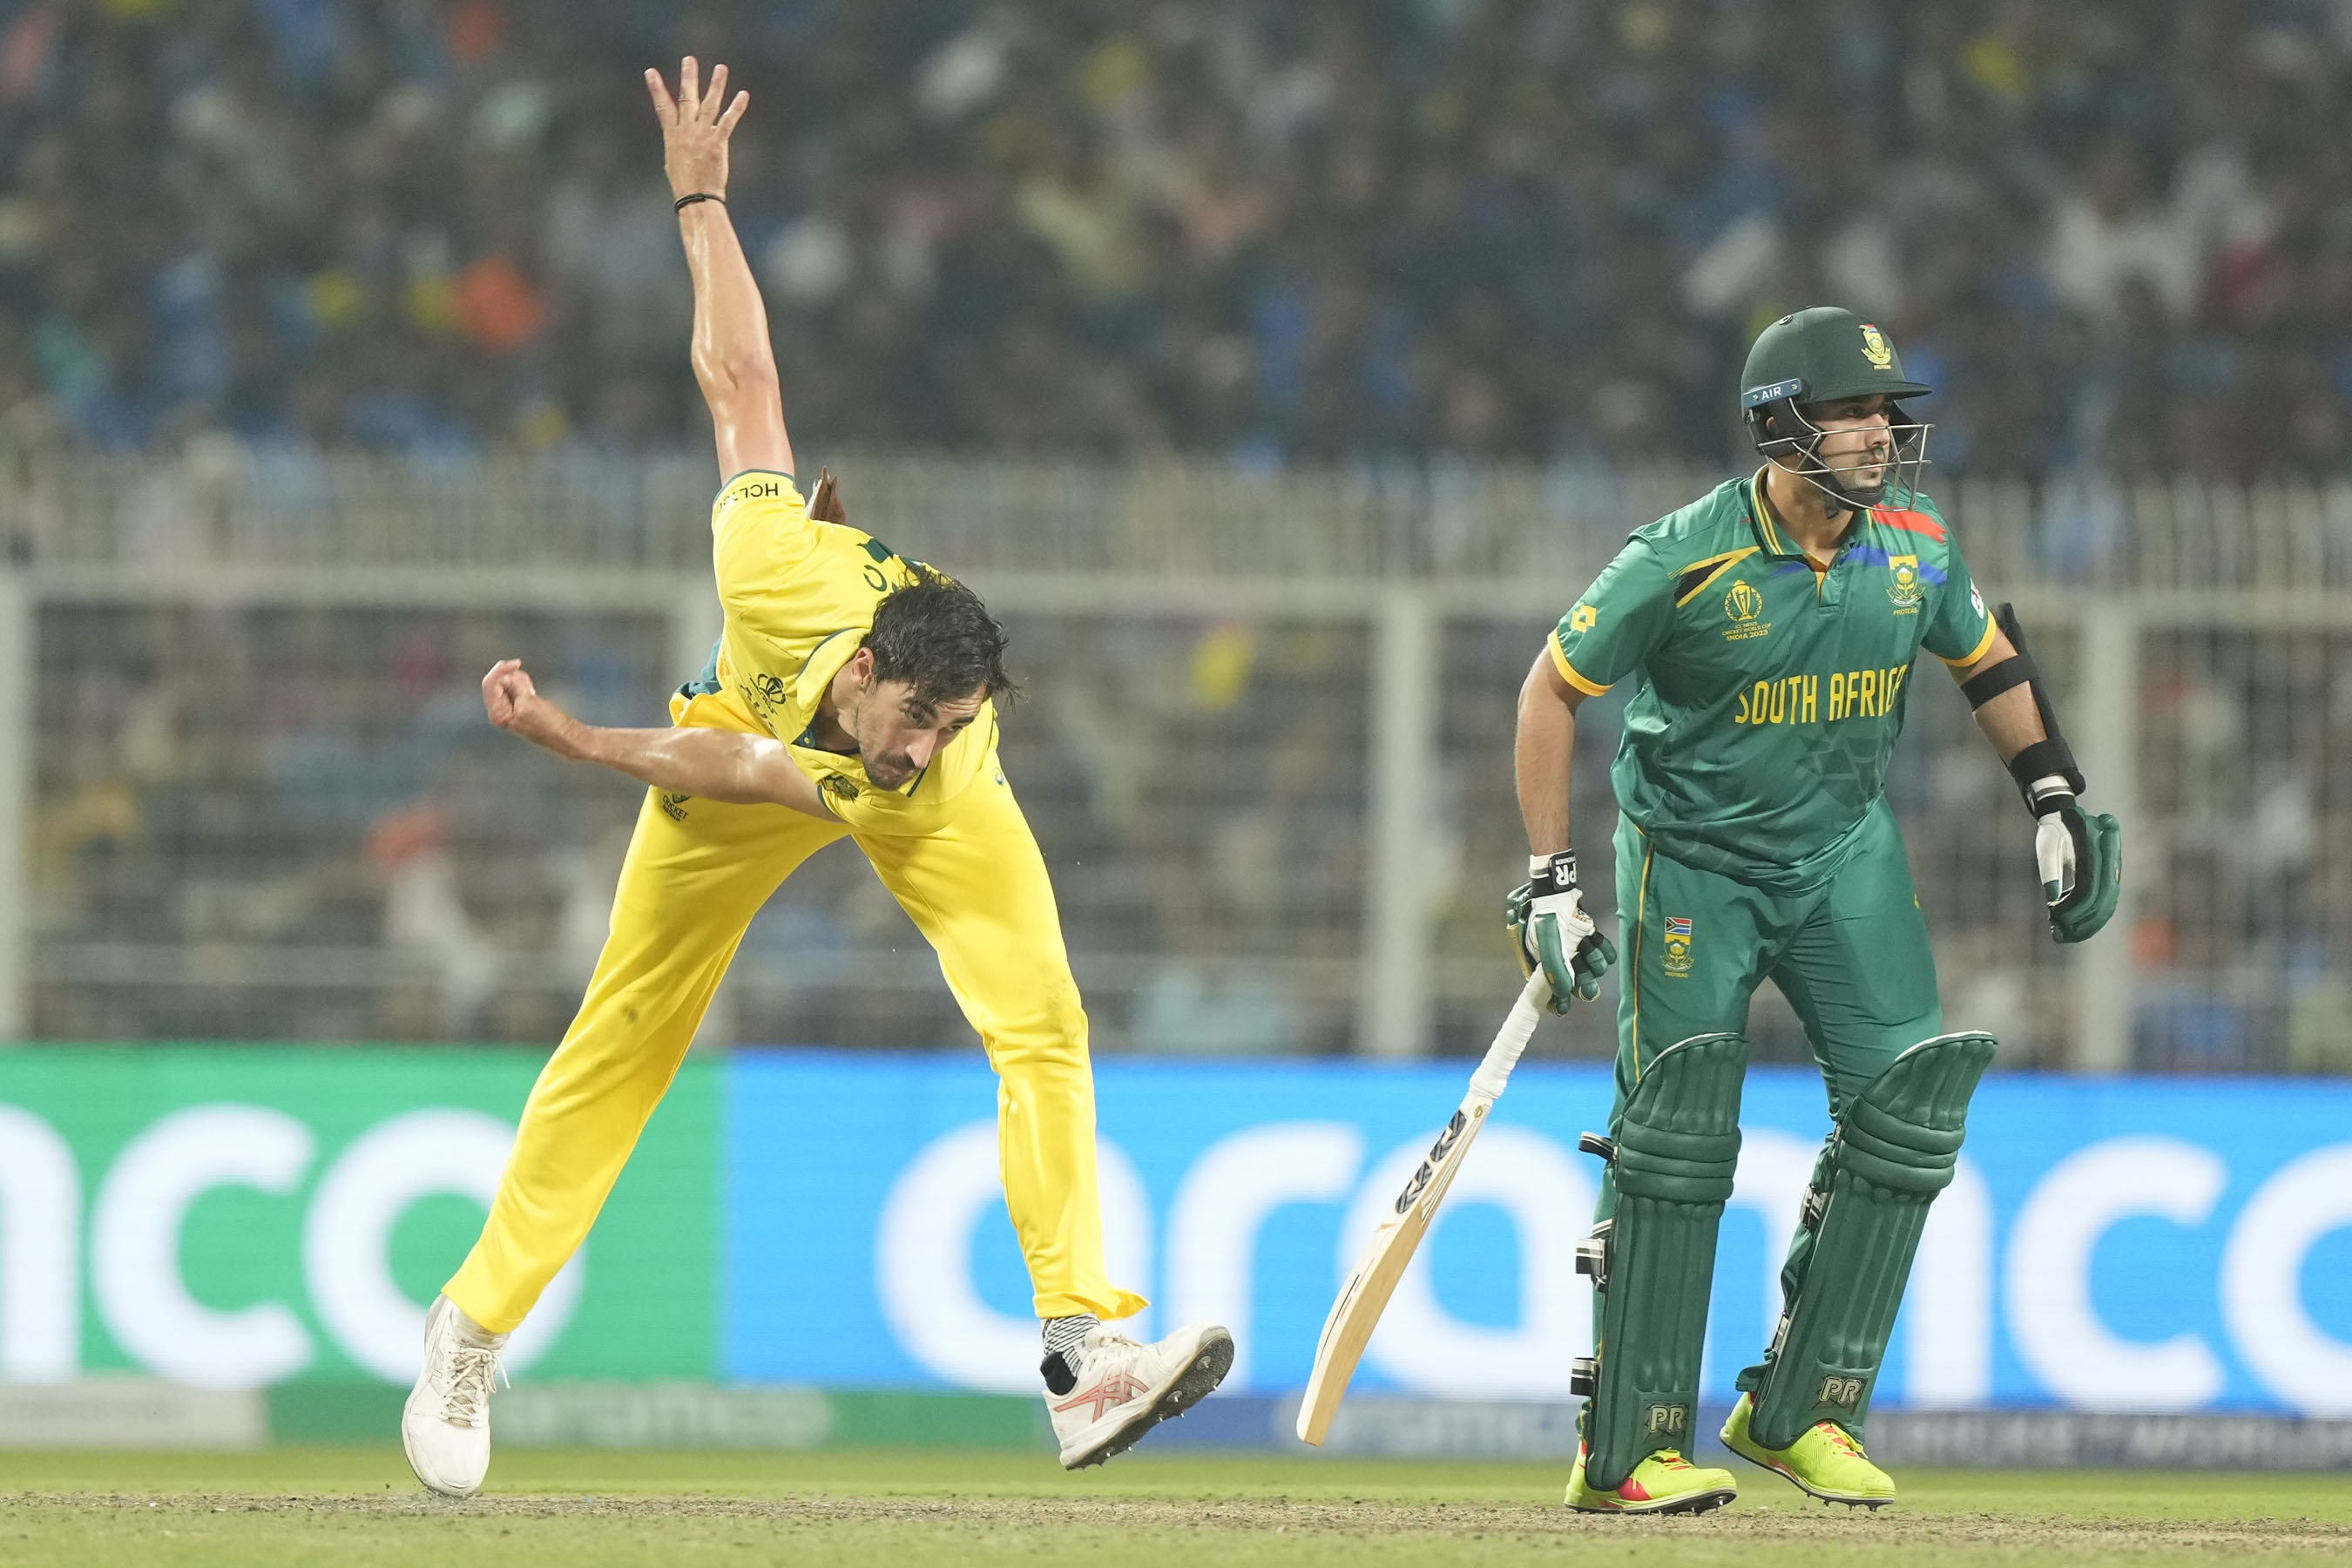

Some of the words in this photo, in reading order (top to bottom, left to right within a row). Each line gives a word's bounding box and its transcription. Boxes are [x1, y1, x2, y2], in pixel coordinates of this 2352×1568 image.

[1761, 386, 1782, 401] AIR
[1749, 629, 1768, 638] 2023
[1734, 674, 1818, 725] SOUTH
[662, 794, 689, 820] CRICKET
[1555, 862, 1577, 886] PR
[1819, 1375, 1862, 1404] PR
[1648, 1404, 1686, 1432] PR
